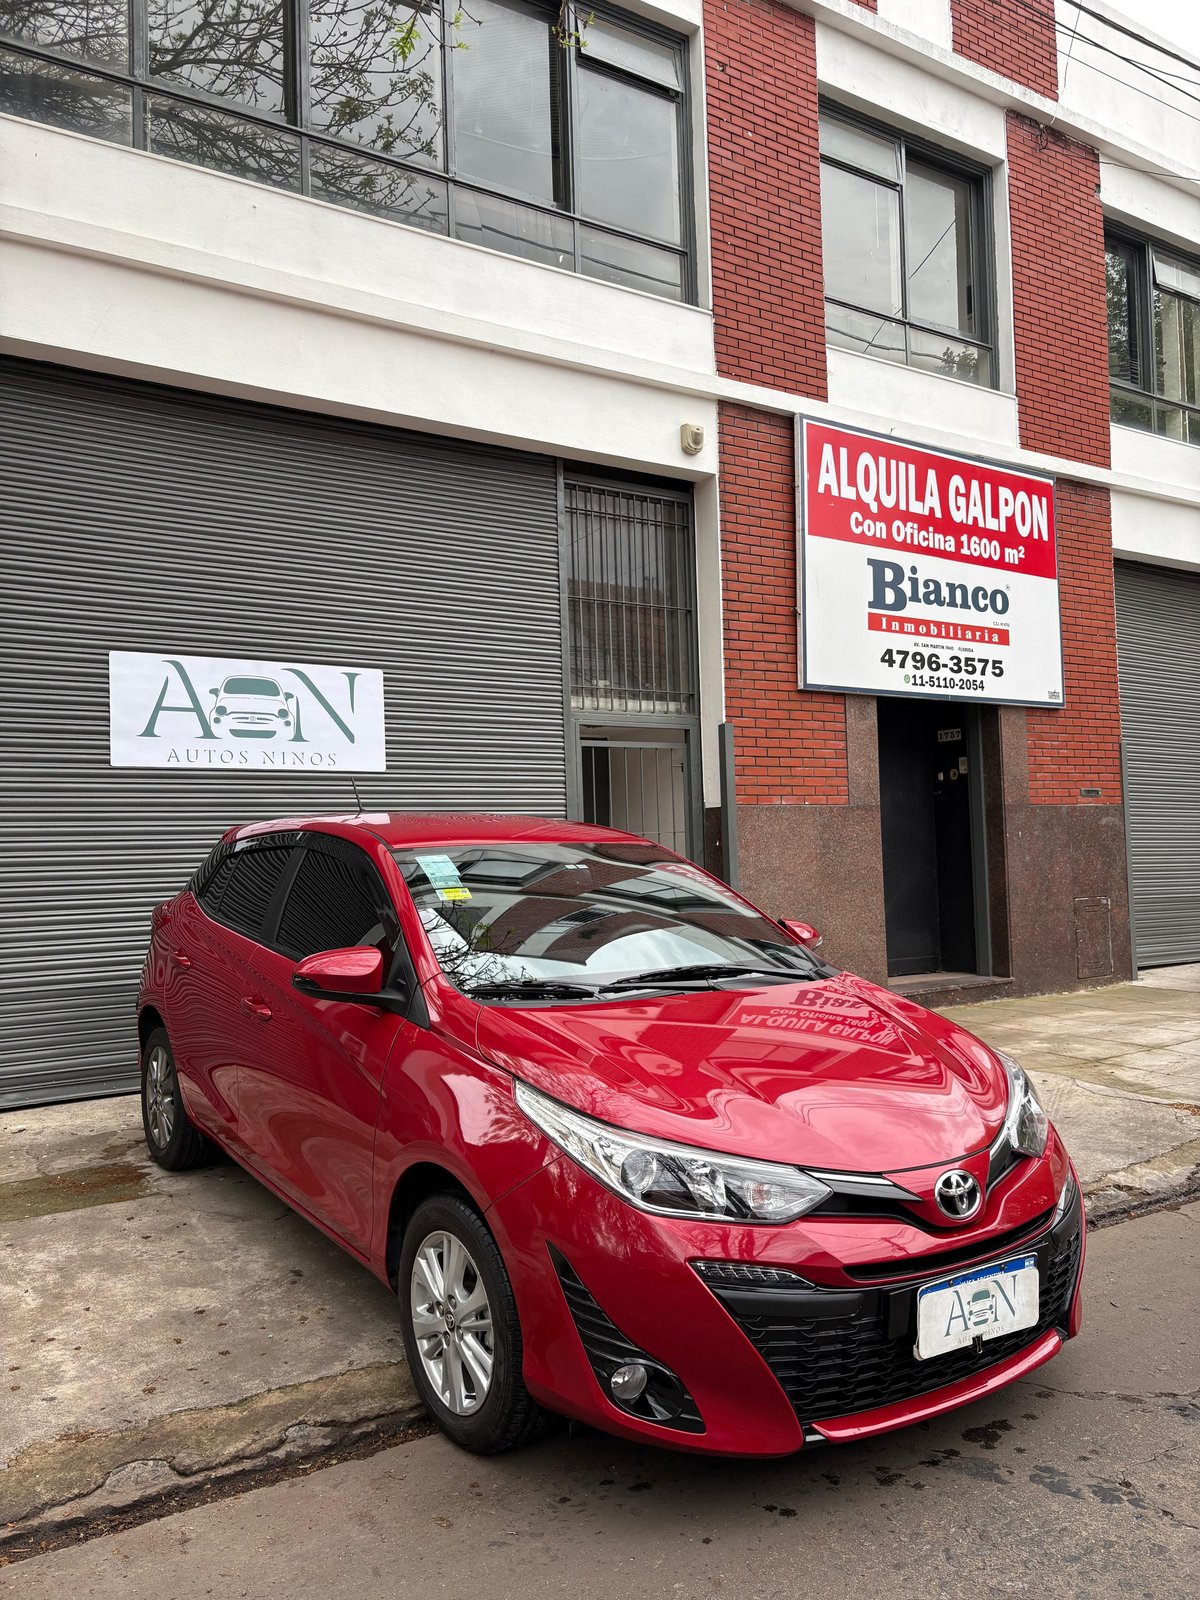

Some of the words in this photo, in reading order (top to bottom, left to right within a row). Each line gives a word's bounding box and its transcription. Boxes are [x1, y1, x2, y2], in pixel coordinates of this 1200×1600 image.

[817, 443, 942, 518] ALQUILA
[948, 474, 1048, 541] GALPON
[850, 511, 887, 539] Con
[892, 520, 955, 552] Oficina
[960, 534, 1000, 561] 1600
[867, 558, 1009, 614] Bianco
[881, 617, 999, 642] Inmobiliaria
[880, 648, 1004, 678] 4796-3575
[911, 674, 985, 691] 11-5110-2054
[939, 730, 961, 741] 1757
[167, 748, 249, 764] AUTOS
[262, 750, 338, 766] NINOS
